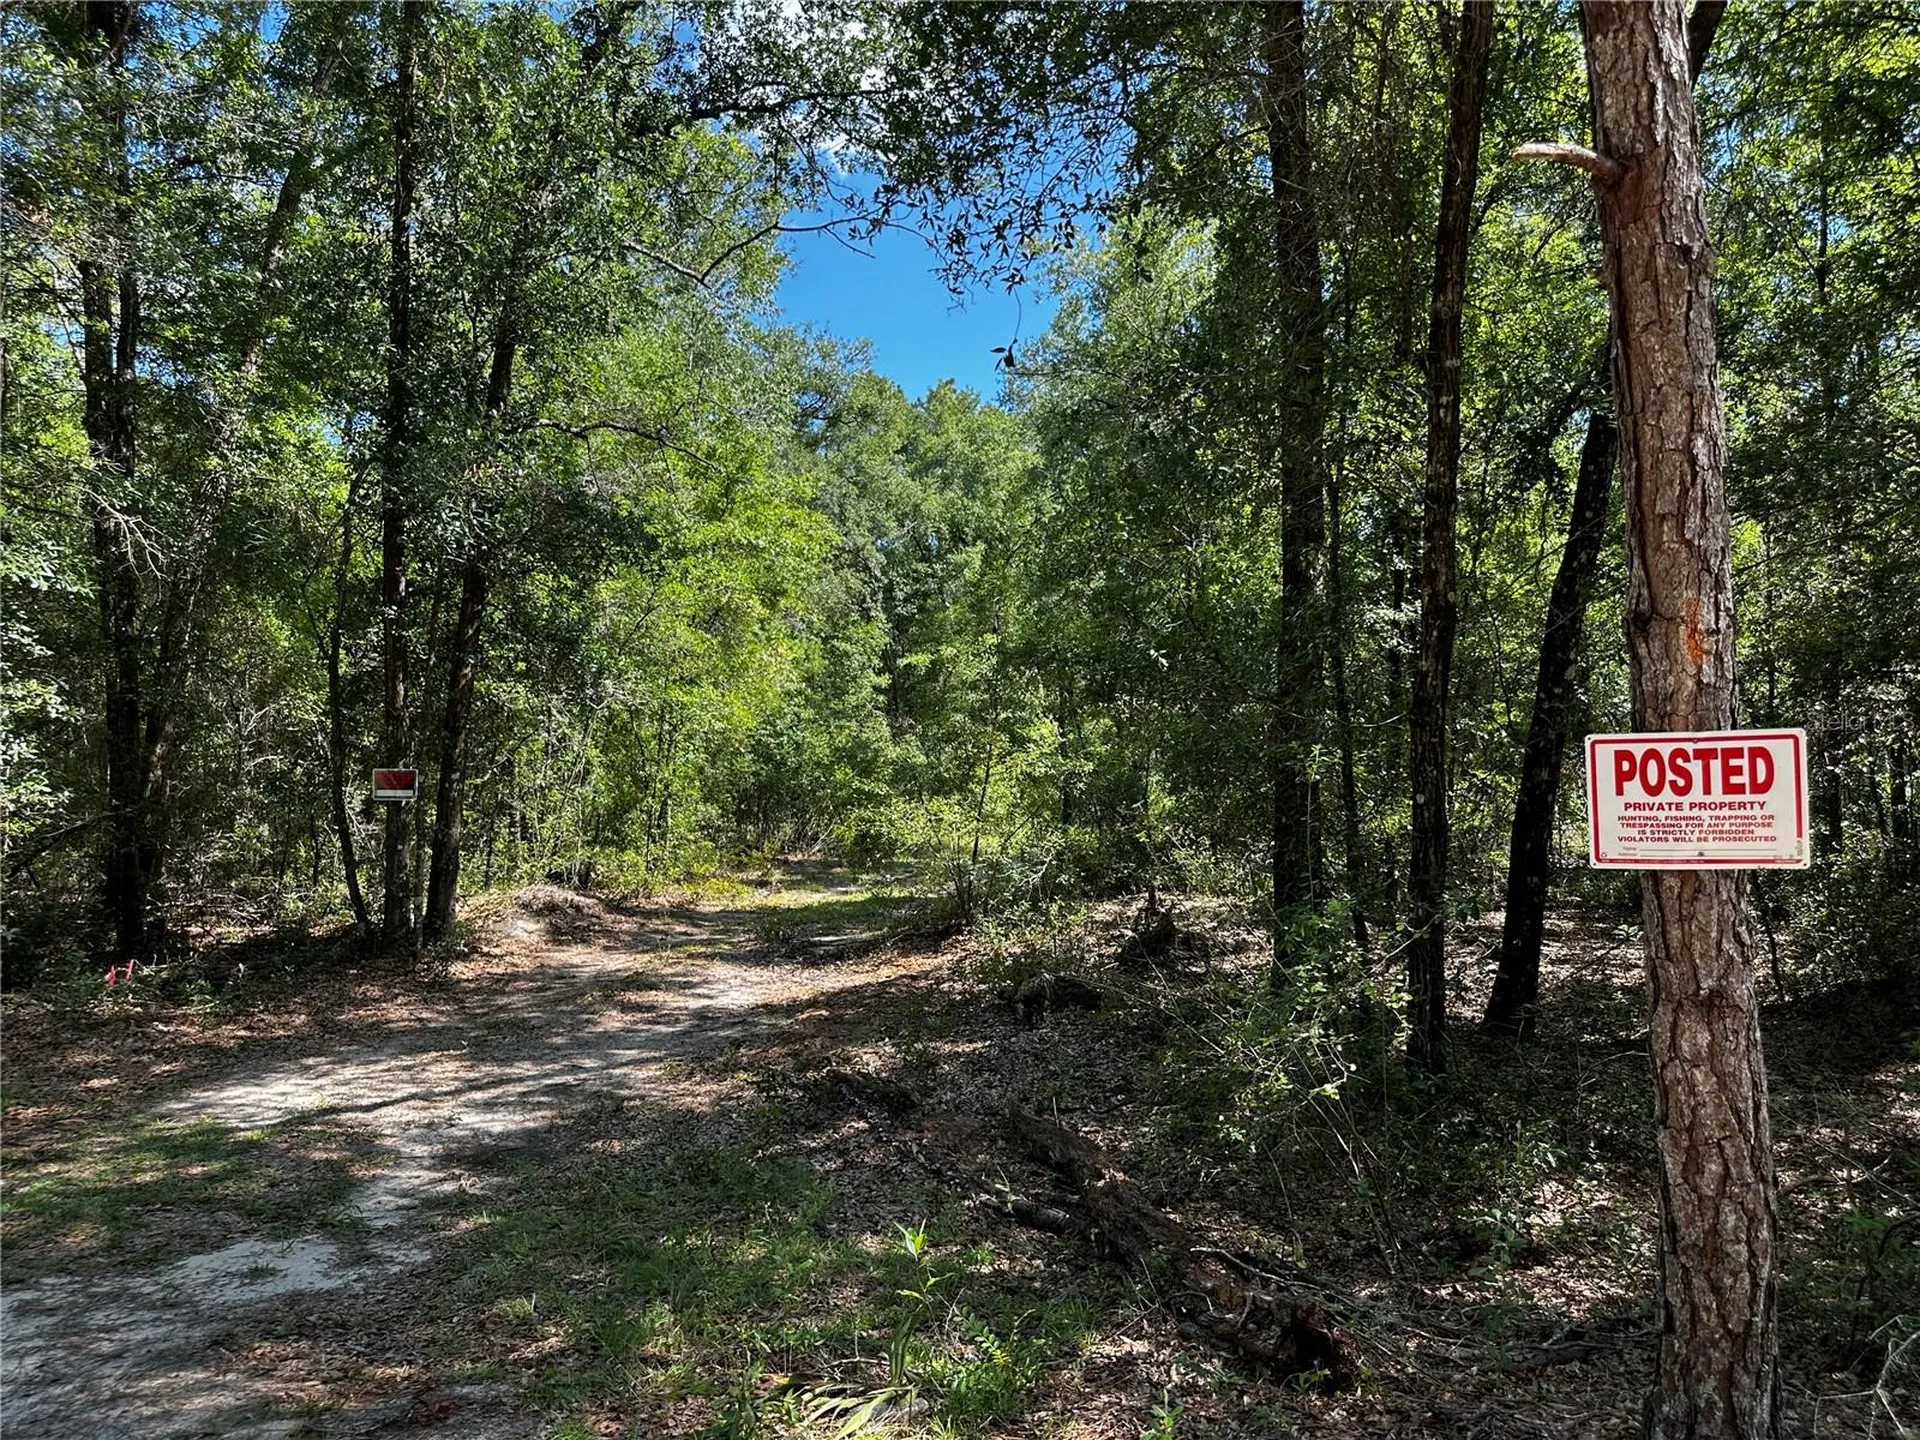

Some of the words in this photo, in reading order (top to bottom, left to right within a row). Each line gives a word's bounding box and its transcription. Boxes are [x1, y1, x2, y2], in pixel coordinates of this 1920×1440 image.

[1613, 746, 1775, 797] POSTED
[1624, 802, 1684, 811] PRIVATE
[1689, 801, 1767, 811] PROPERTY
